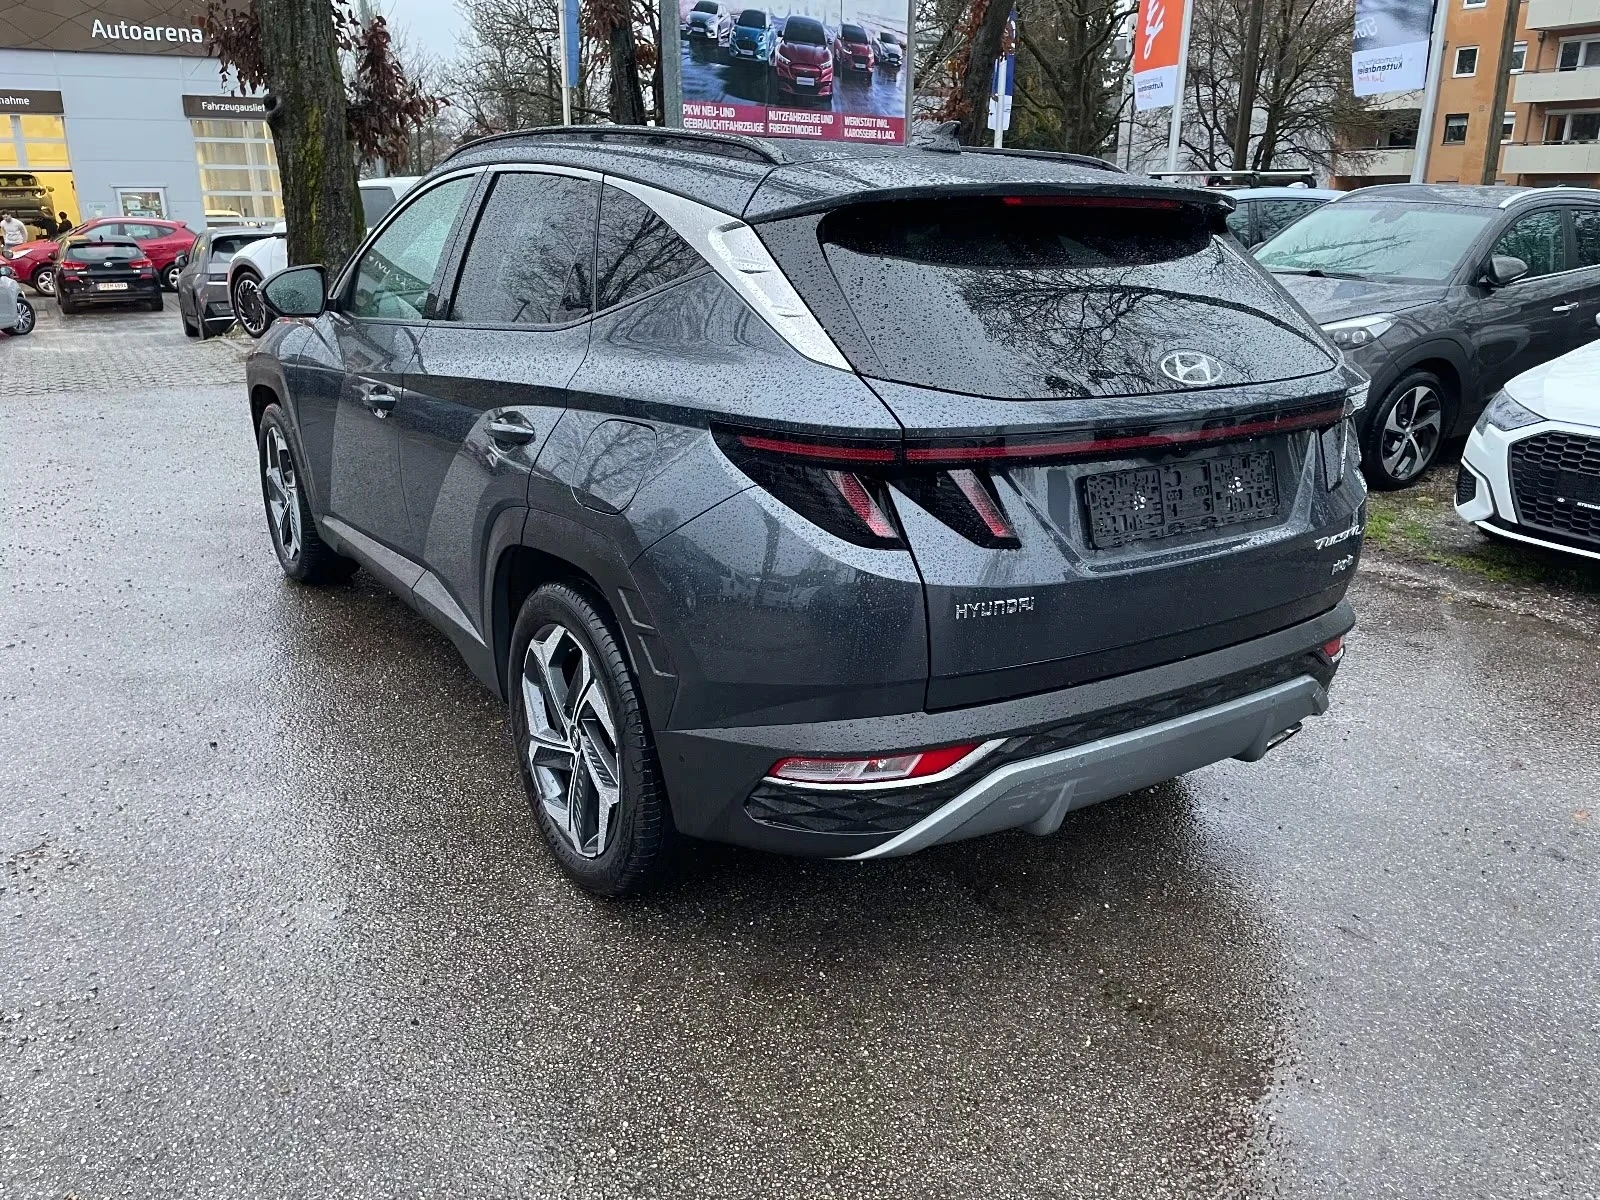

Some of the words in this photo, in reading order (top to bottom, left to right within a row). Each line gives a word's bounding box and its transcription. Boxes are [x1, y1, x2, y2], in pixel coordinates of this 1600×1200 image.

[91, 19, 203, 43] Autoarena
[0, 95, 30, 105] nahme
[682, 104, 700, 116] PKW
[702, 106, 719, 117] NEU-
[720, 107, 735, 118] UND
[768, 110, 820, 123] NUTZFAHRZEUGE
[820, 114, 834, 125] UND
[683, 118, 765, 133] GEBRAUCHTFAHRZEUGE
[844, 116, 876, 128] WERKSTATT
[768, 123, 822, 136] FREIZEITMODELLE
[844, 128, 877, 139] KAROSSERIE
[882, 131, 896, 140] LACK
[955, 596, 1035, 620] HYUNDAI
